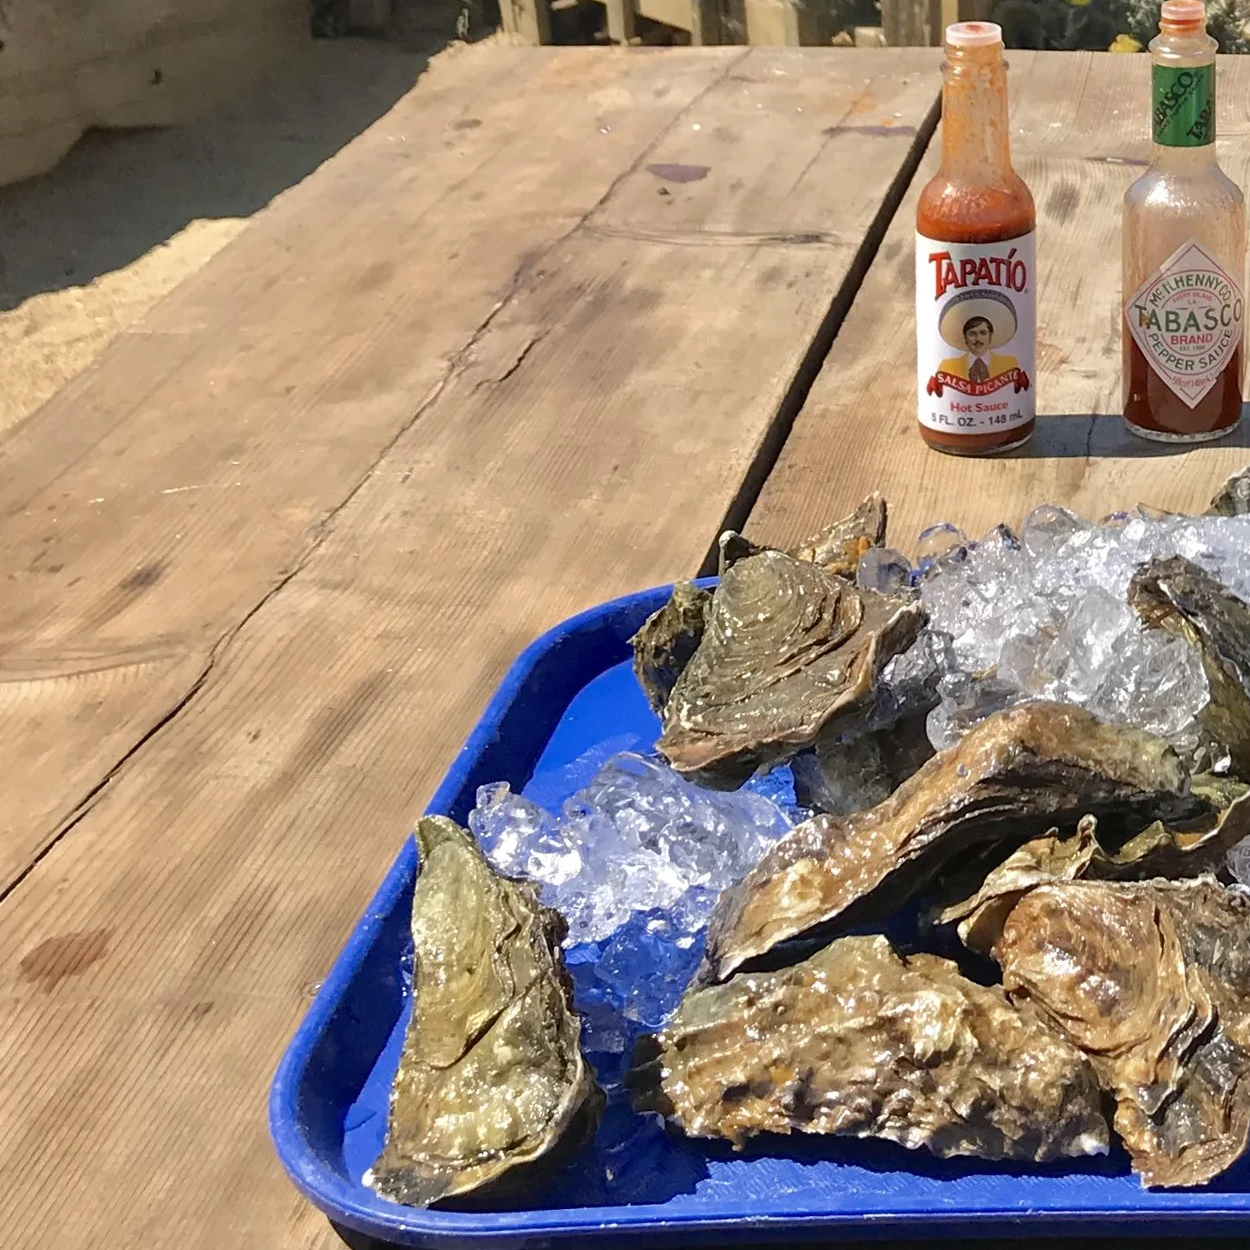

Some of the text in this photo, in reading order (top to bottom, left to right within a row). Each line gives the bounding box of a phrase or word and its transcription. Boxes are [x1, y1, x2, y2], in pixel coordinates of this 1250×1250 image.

[929, 248, 1027, 301] TAPATÍO
[1134, 298, 1243, 334] TABASCO
[1149, 329, 1233, 371] PEPPER SAUCE
[1170, 333, 1213, 346] BRAND
[936, 369, 1020, 395] SALSA PICANTE
[931, 412, 937, 422] 5
[988, 415, 1007, 426] 148
[1009, 409, 1023, 422] mL
[950, 401, 1009, 413] Hot Sauce
